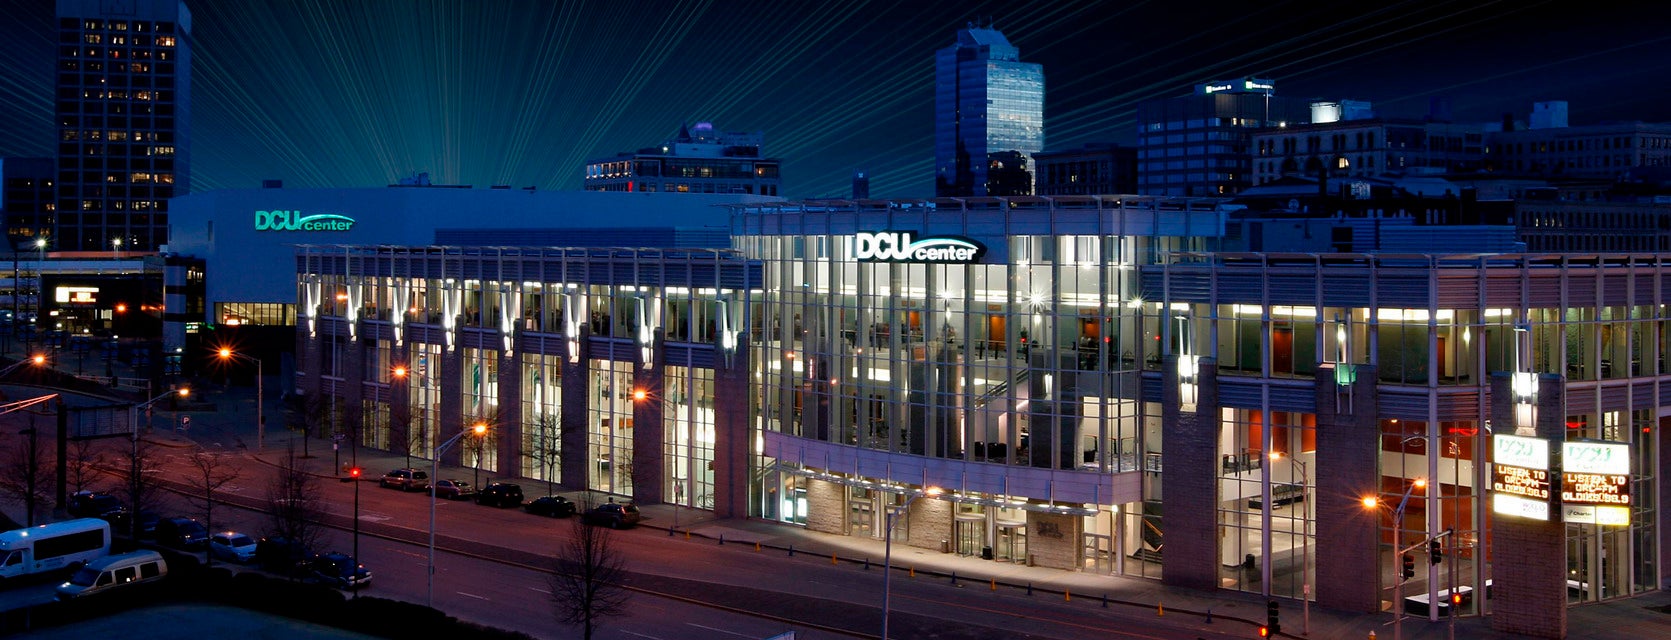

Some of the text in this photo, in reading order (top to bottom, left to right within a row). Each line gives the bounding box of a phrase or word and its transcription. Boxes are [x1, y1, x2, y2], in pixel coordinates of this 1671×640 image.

[255, 209, 353, 231] DCU center
[856, 232, 977, 260] DCU center
[1498, 465, 1546, 480] LISTEN TO
[1567, 474, 1626, 485] LISTEN TO
